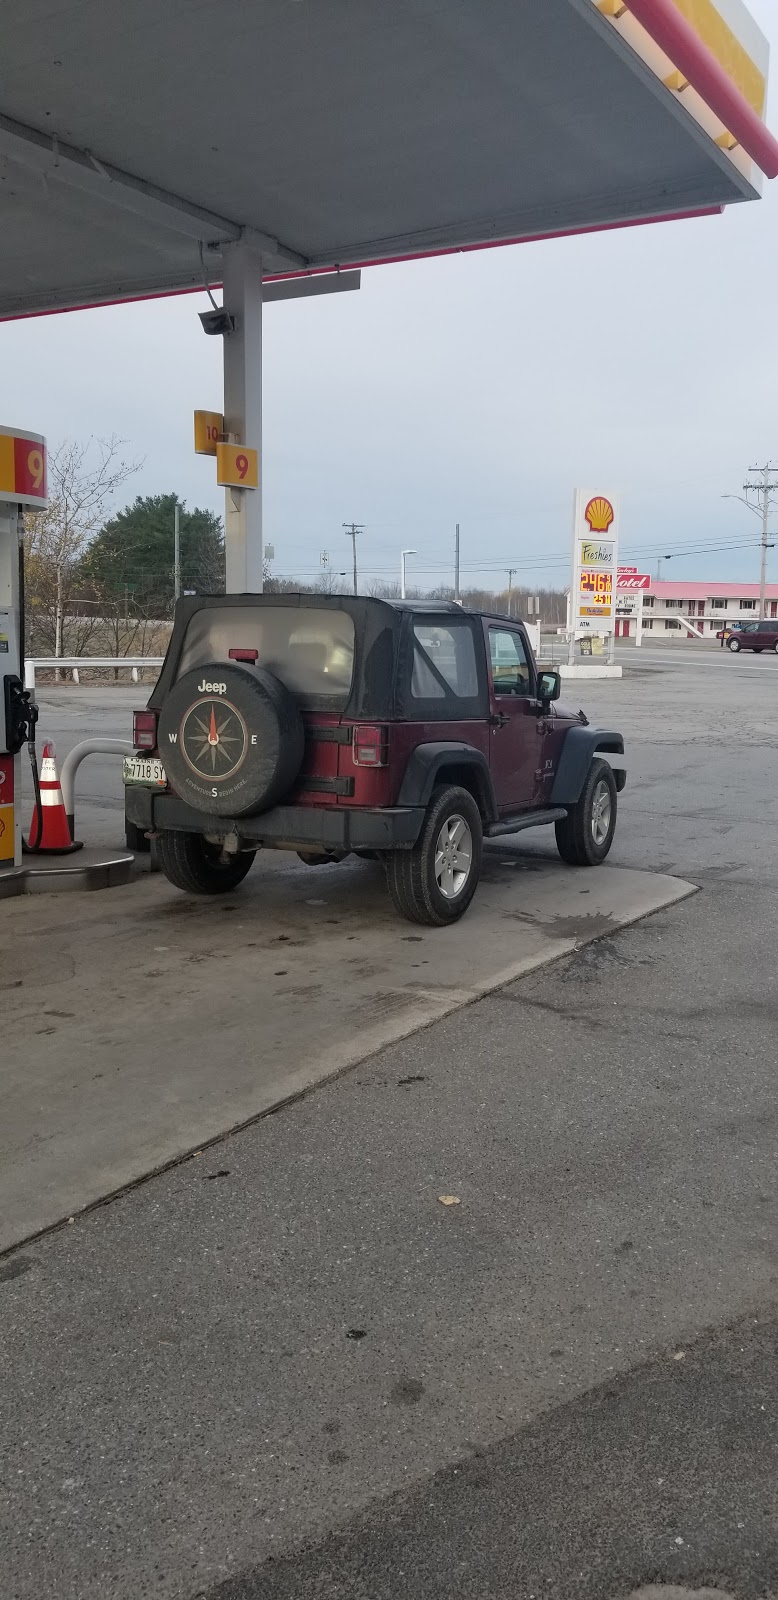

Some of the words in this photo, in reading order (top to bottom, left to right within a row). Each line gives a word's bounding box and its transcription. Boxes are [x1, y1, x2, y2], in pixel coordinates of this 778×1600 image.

[206, 426, 218, 442] 10
[28, 450, 44, 488] 9
[236, 454, 248, 480] 9
[583, 544, 612, 562] Freshies
[198, 680, 227, 695] Jeep
[168, 734, 178, 743] W
[251, 735, 257, 744] E
[131, 764, 151, 778] 7718
[154, 766, 164, 780] SY
[212, 788, 217, 797] S
